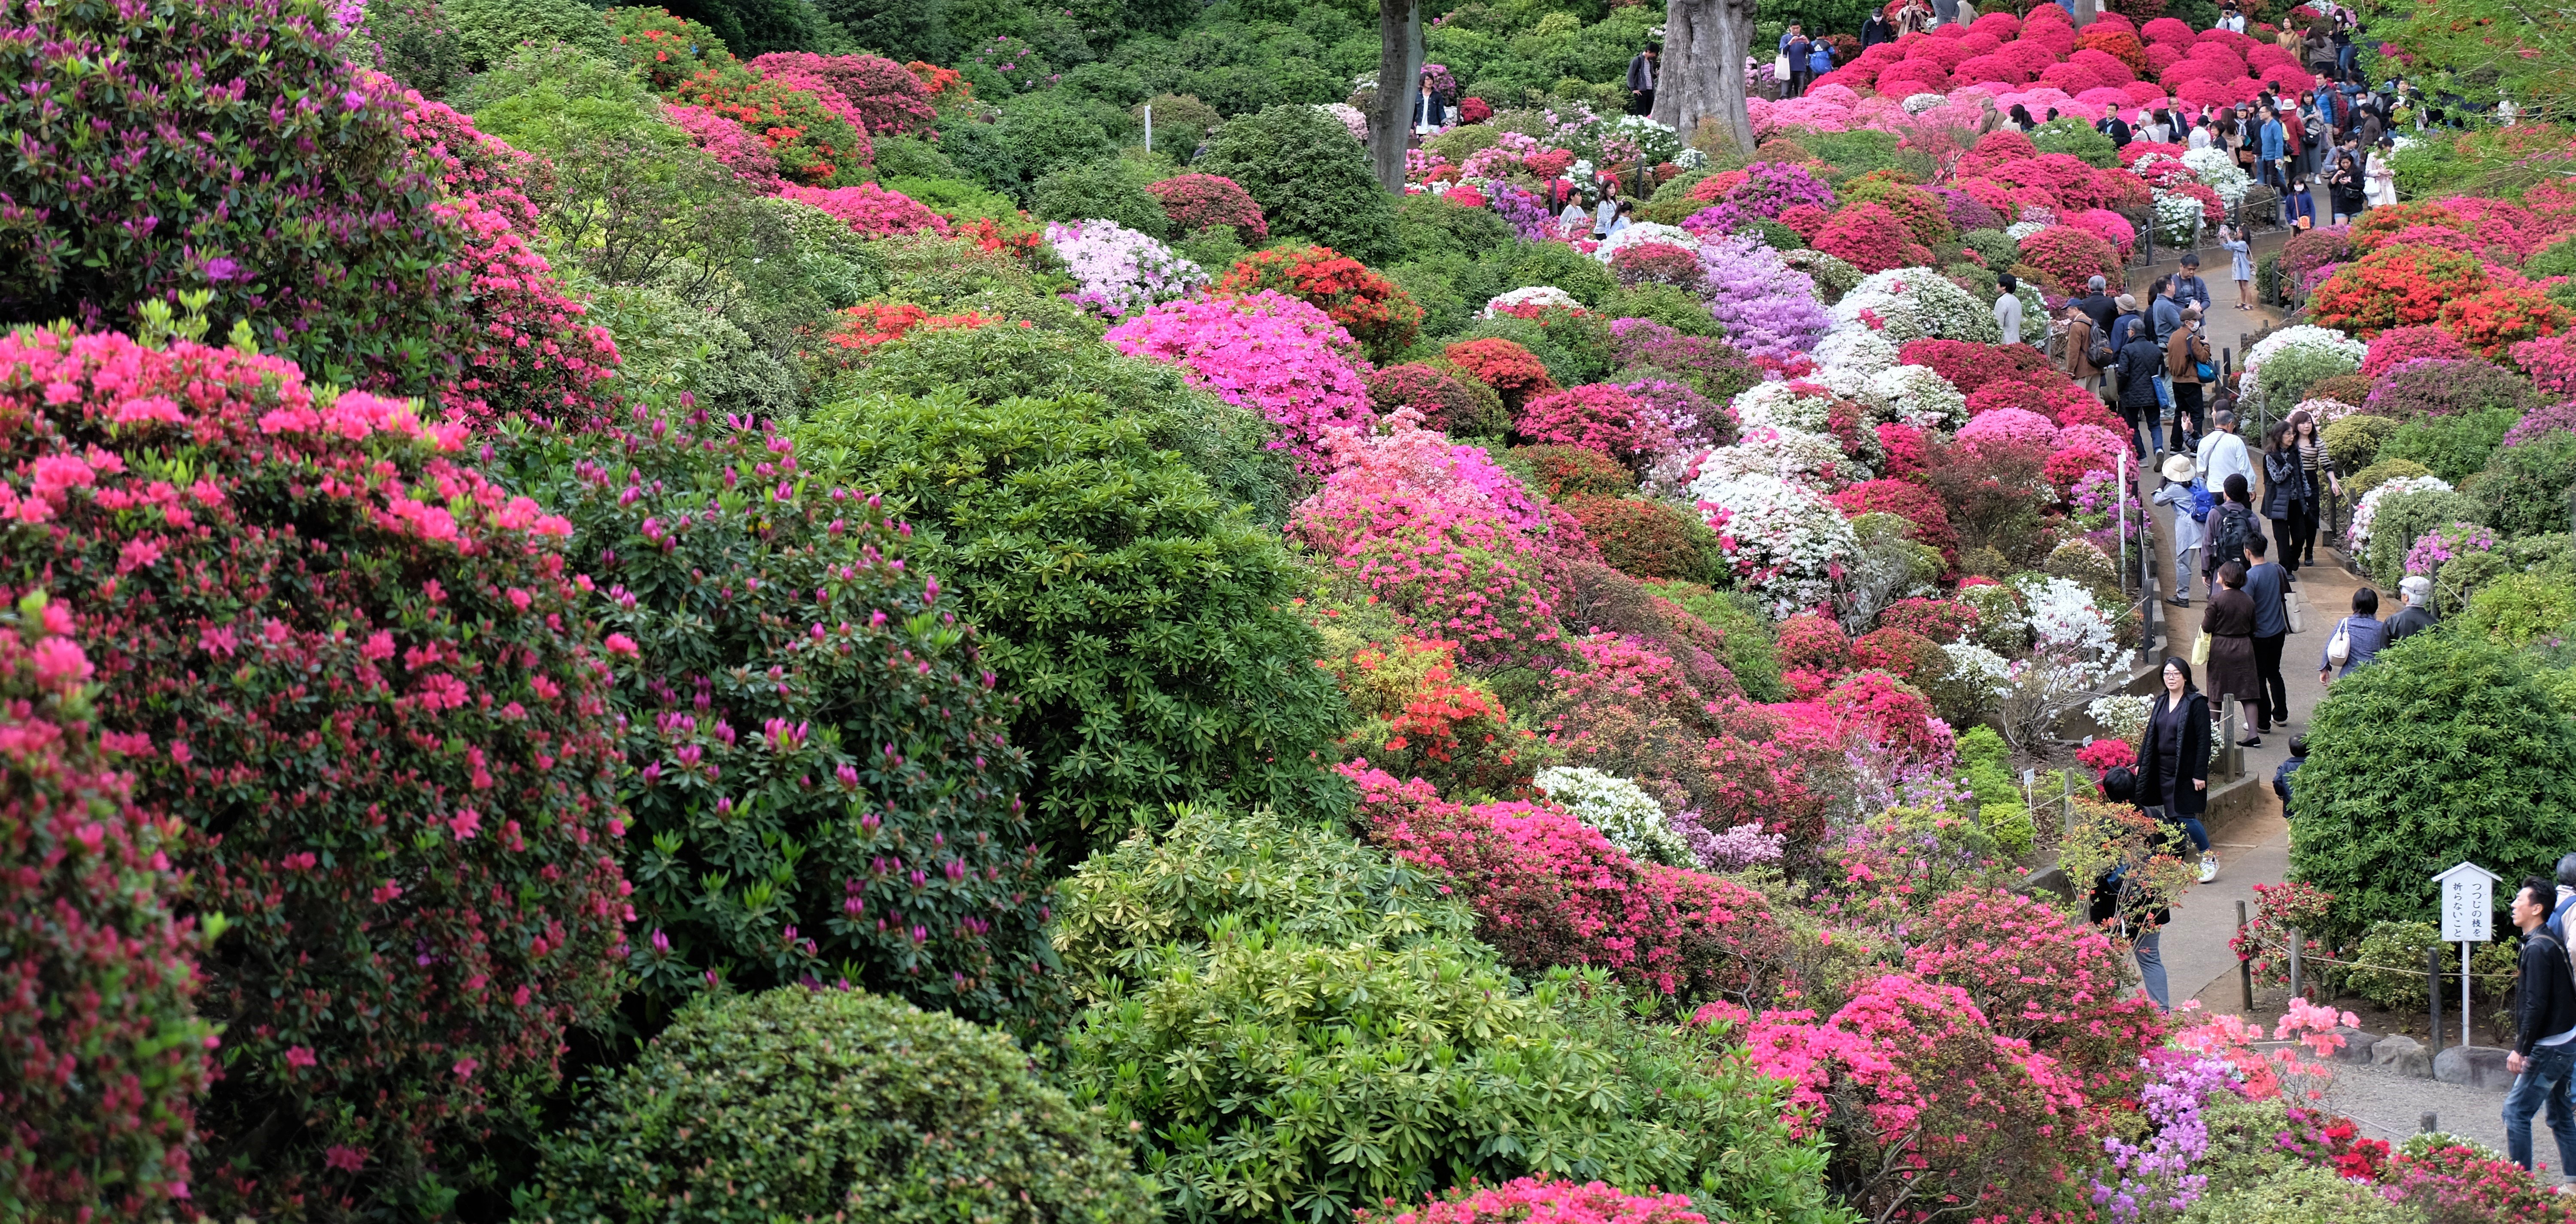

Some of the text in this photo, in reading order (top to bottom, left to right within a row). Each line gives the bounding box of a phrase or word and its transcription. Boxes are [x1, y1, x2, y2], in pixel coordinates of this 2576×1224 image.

[2453, 883, 2463, 937] 折らないこと
[2472, 883, 2482, 937] つつじの枝を
